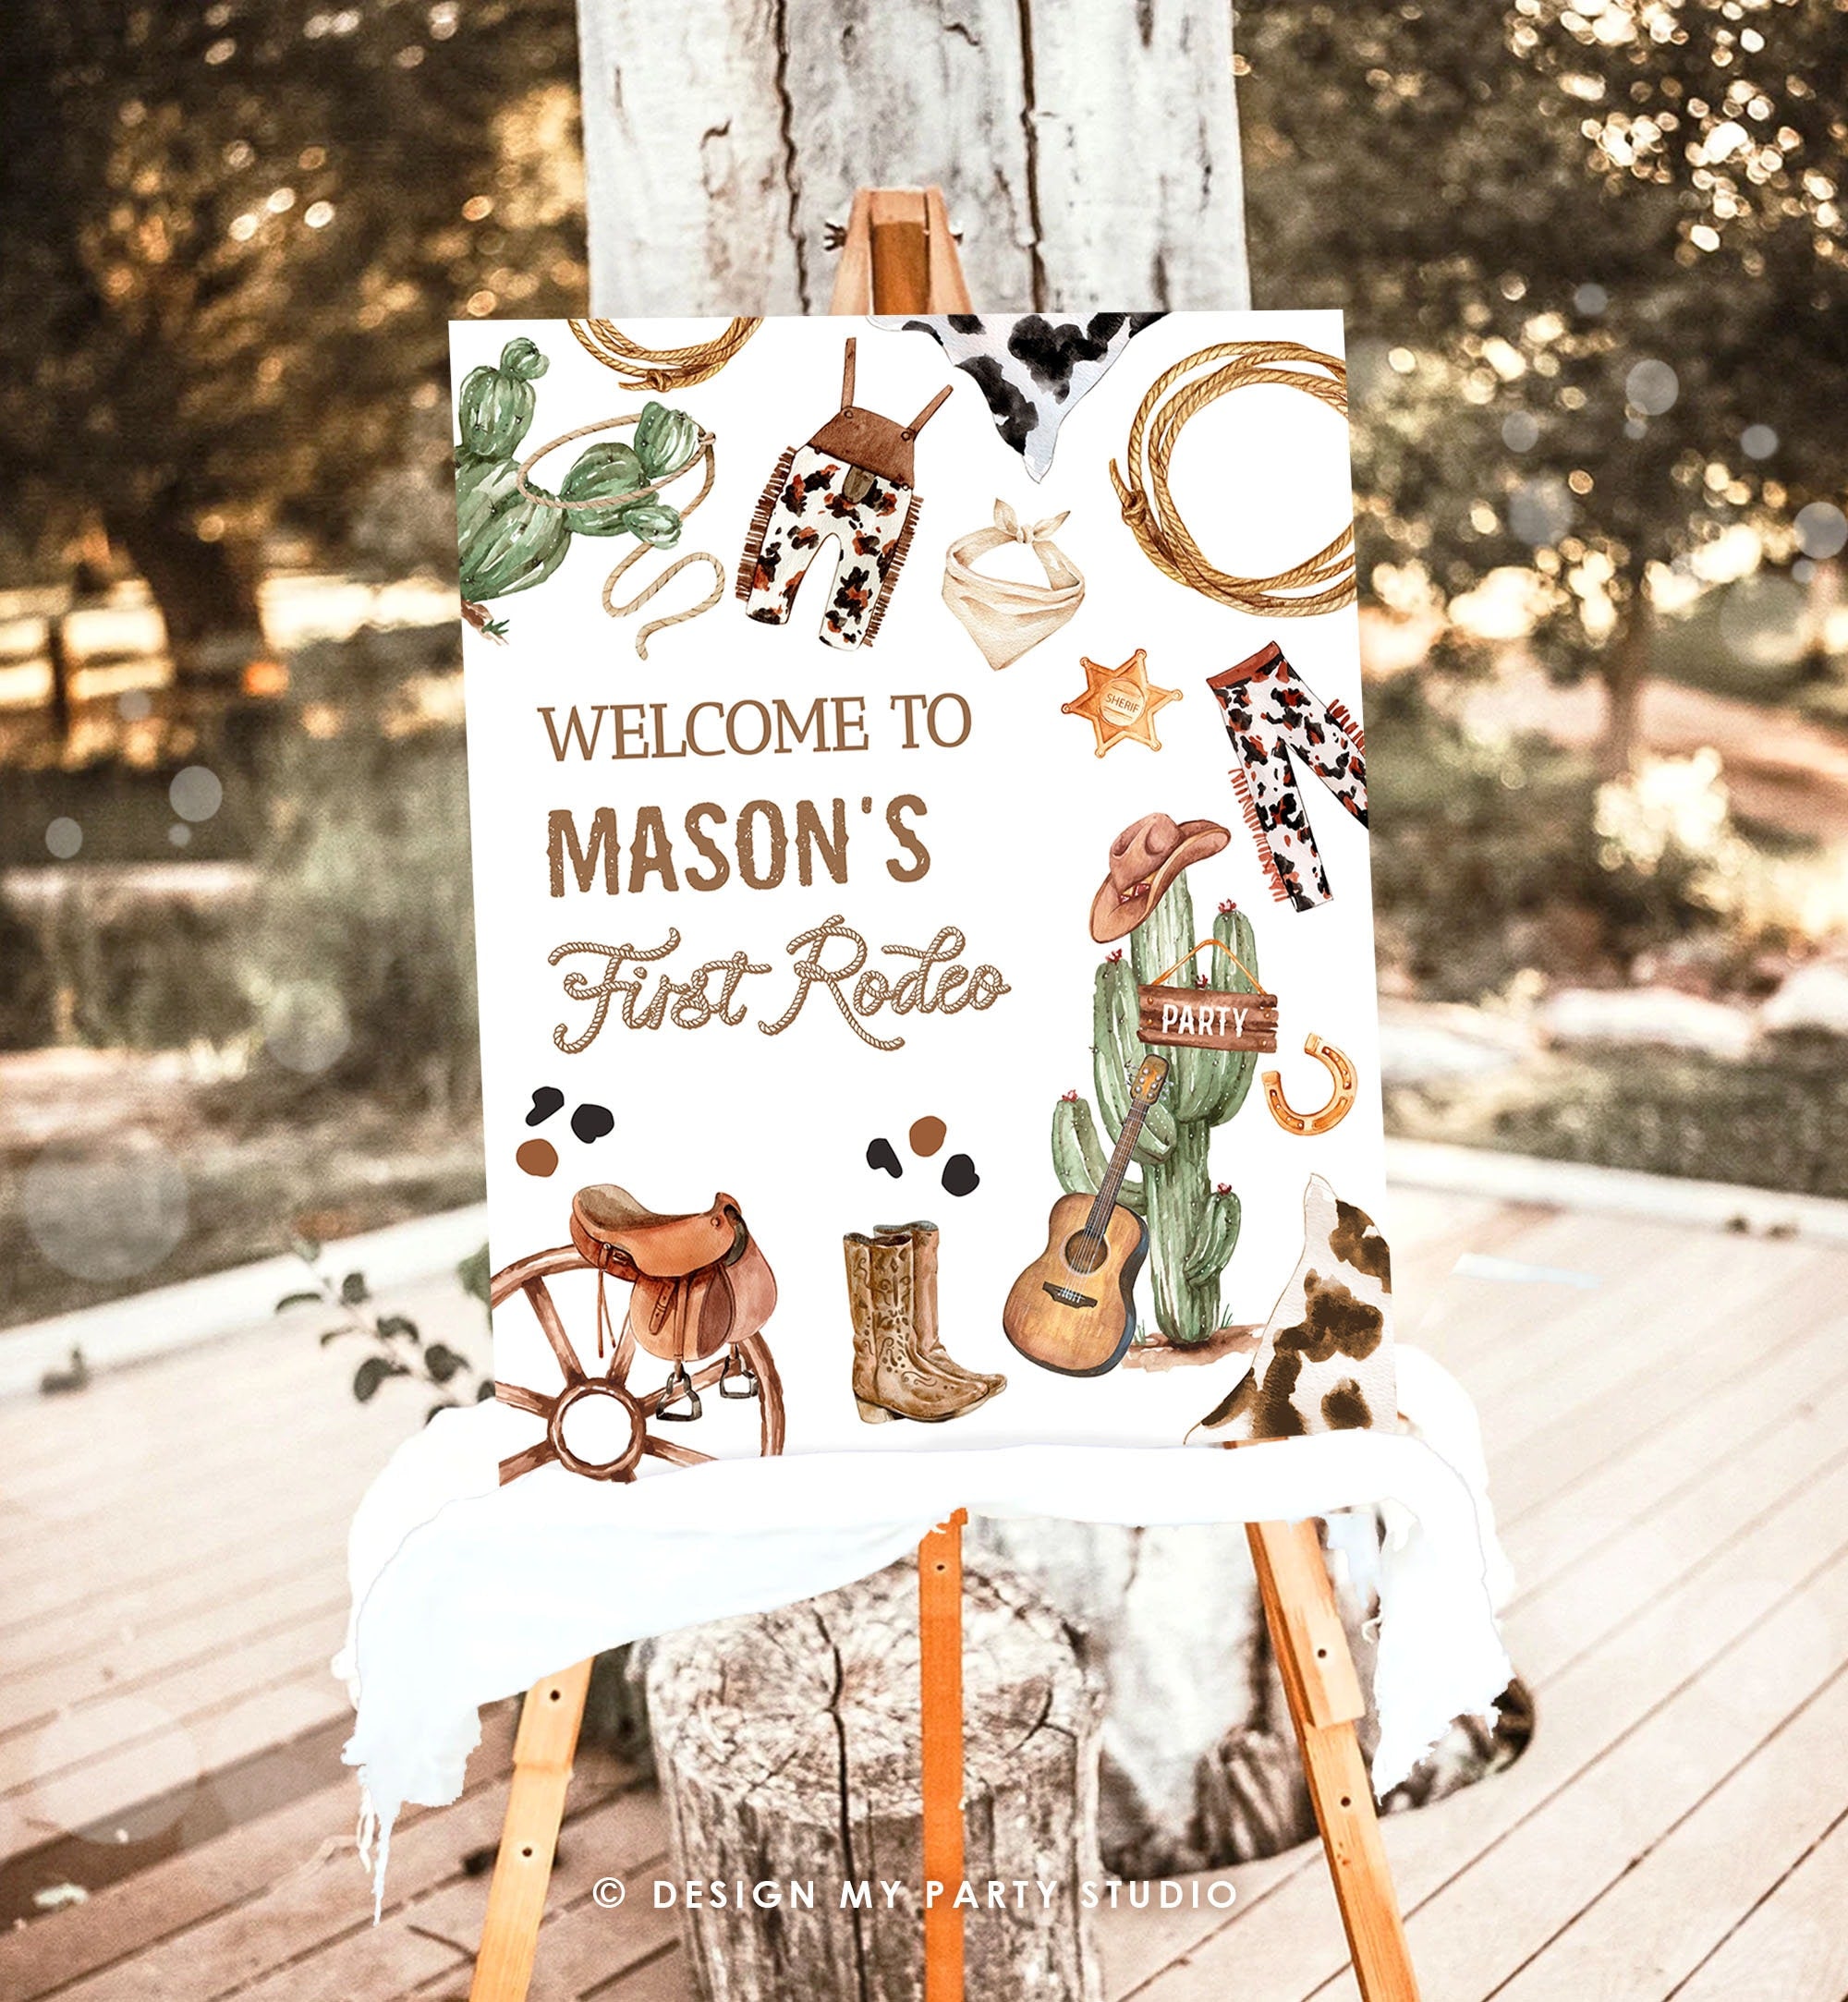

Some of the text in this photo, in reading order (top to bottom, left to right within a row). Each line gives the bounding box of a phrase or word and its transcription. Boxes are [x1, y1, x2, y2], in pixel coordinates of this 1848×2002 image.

[537, 693, 972, 761] WELCOME TO
[1105, 693, 1140, 713] SHERIF
[546, 795, 930, 897] MASON'S
[548, 915, 1012, 1053] First Rodeo
[1161, 1004, 1248, 1037] PARTY
